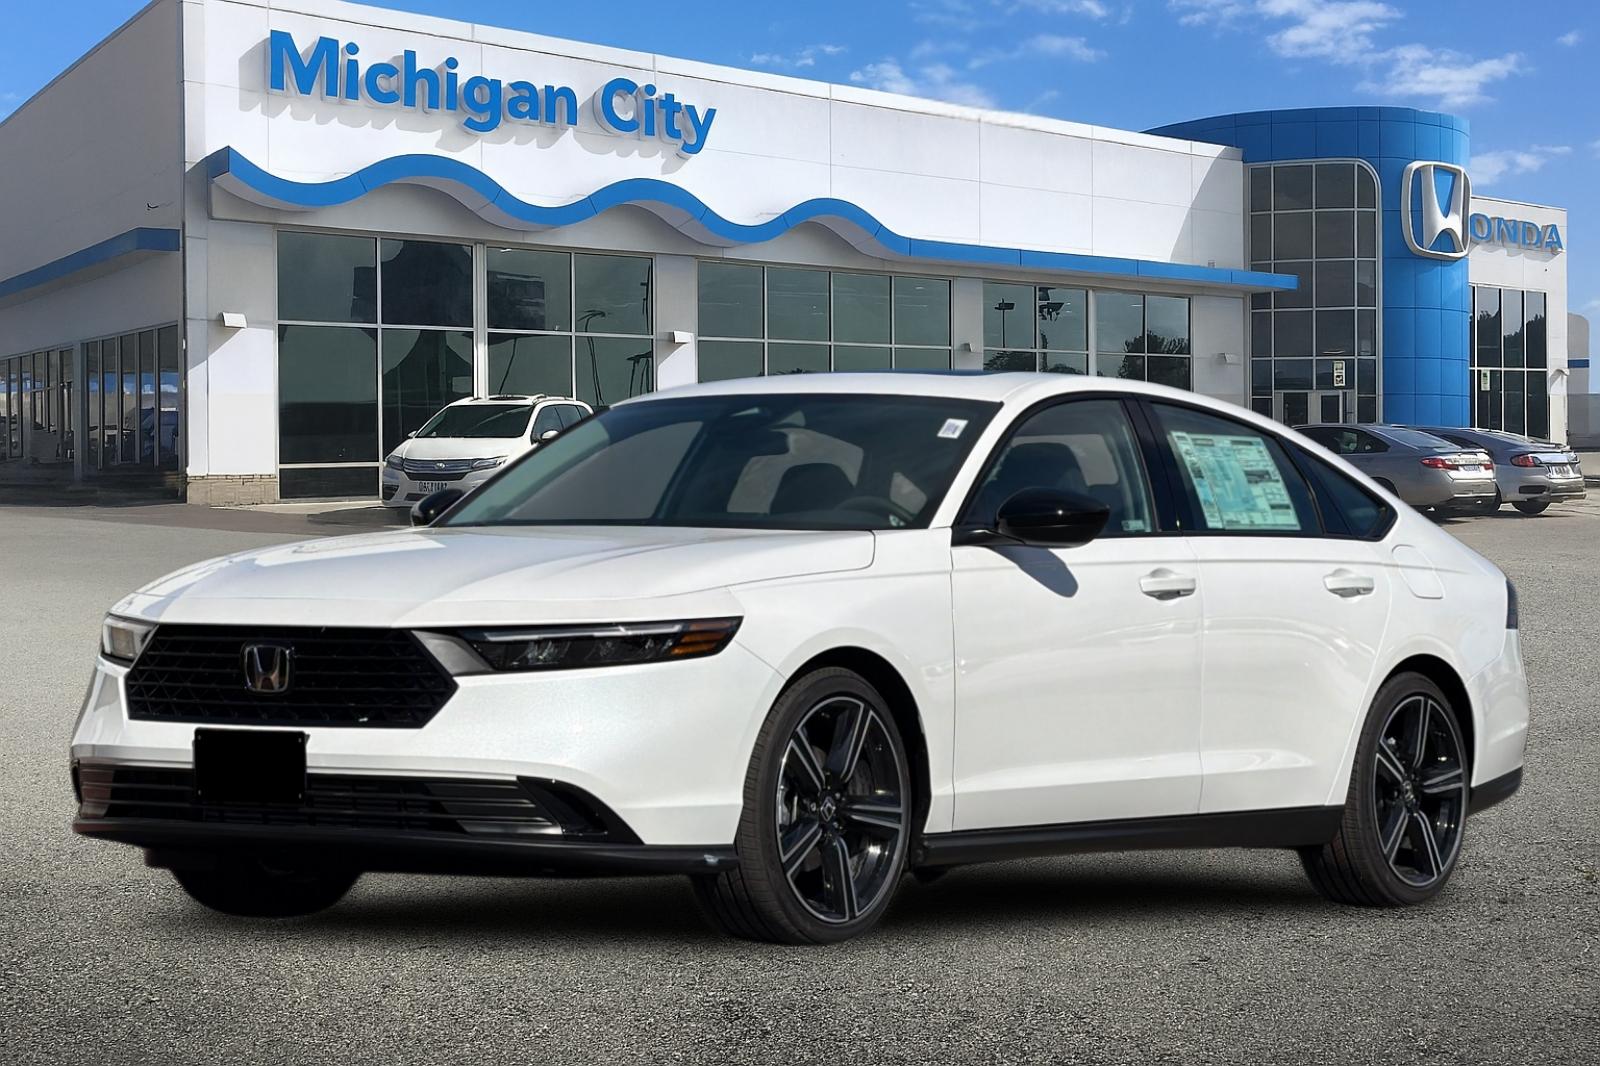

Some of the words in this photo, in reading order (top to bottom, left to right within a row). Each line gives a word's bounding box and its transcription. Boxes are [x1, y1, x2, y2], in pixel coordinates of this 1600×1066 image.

[269, 29, 578, 134] Michigan
[599, 77, 718, 156] City
[1468, 211, 1564, 250] ONDA
